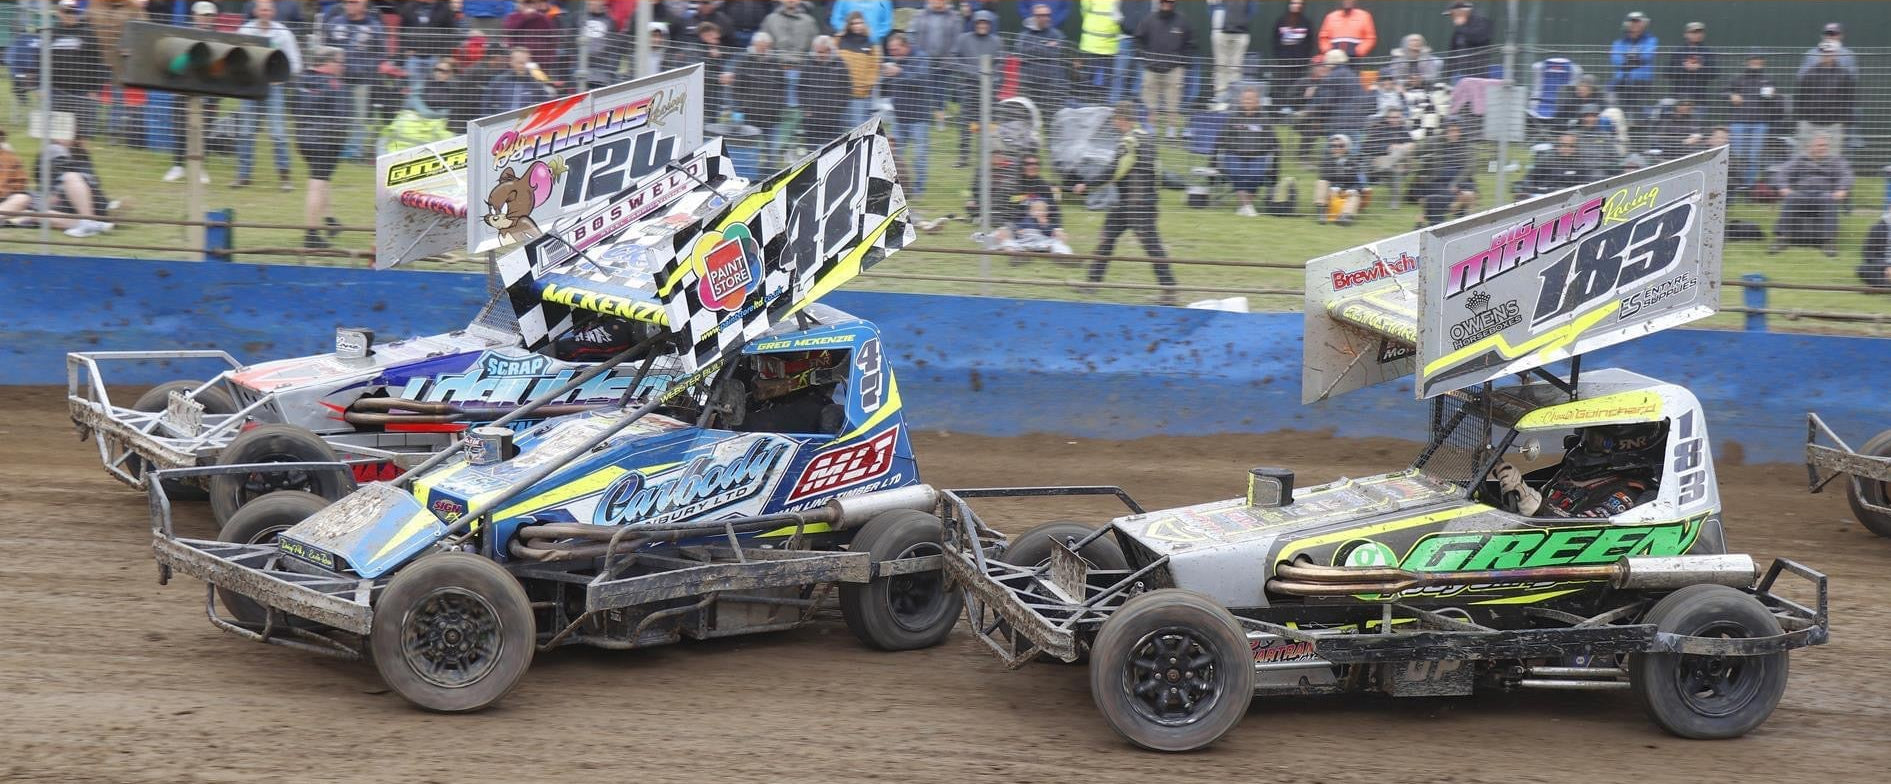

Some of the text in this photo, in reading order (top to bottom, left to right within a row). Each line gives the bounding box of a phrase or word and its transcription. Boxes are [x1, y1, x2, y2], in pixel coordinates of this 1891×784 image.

[559, 129, 680, 209] 124
[1444, 187, 1660, 300] MAUS Racing
[1490, 218, 1536, 249] BIG
[710, 256, 744, 284] PAINT
[1530, 201, 1697, 331] 183
[714, 269, 749, 297] STORE
[1643, 278, 1697, 308] SUPPLIES
[1644, 272, 1689, 299] ENTYRE
[1450, 299, 1521, 341] OWENS
[1618, 292, 1642, 321] ES
[757, 334, 857, 351] GREG MCKENZIE
[1452, 314, 1523, 351] HORSEBOXES
[488, 357, 544, 376] SCRAP
[800, 435, 893, 493] MLT
[1674, 408, 1706, 507] 183
[593, 436, 788, 525] Carbody
[880, 473, 902, 488] LTD
[433, 500, 462, 513] SIGN
[714, 487, 748, 506] LTD
[1400, 510, 1712, 572] GREEN
